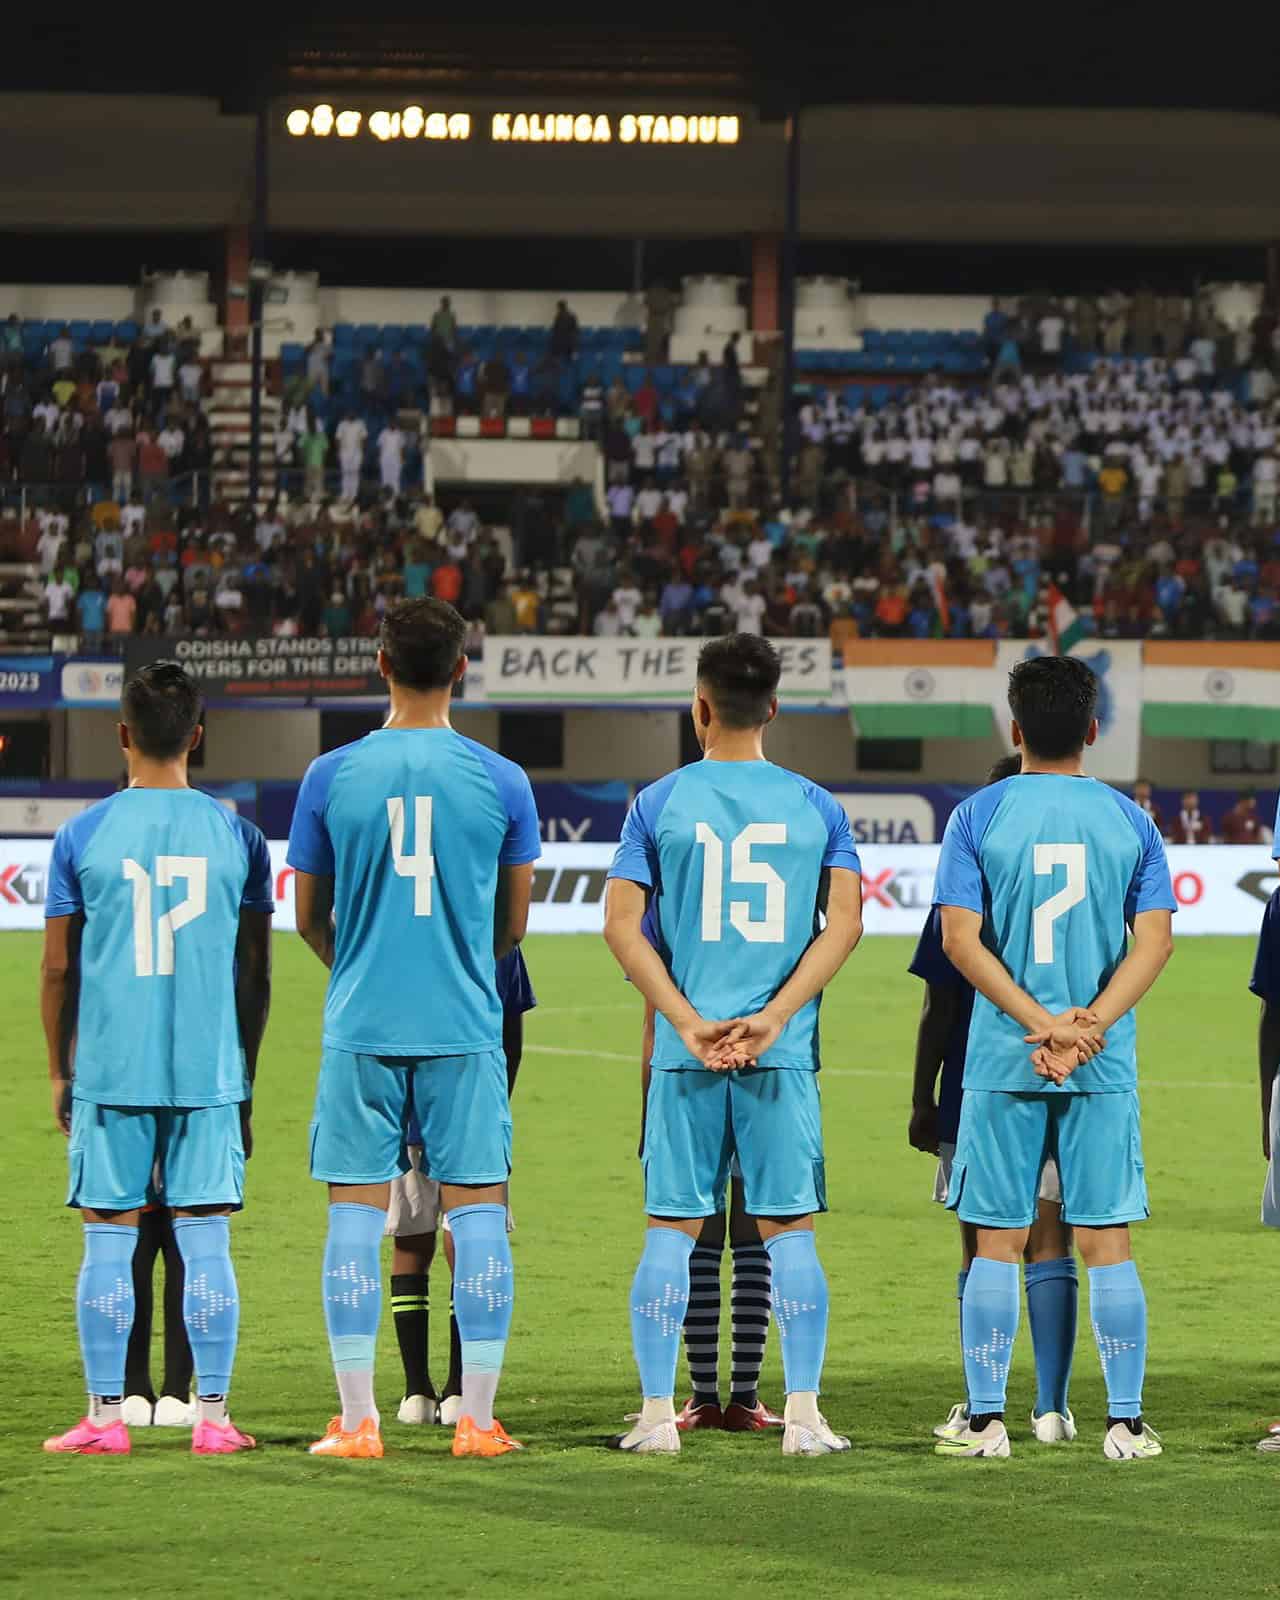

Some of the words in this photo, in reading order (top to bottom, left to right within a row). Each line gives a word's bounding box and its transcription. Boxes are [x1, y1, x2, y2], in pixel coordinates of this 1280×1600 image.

[493, 113, 612, 142] KALINGA
[619, 115, 739, 144] STADIUM
[176, 640, 252, 658] ODISHA
[255, 638, 332, 657] STANDS
[336, 637, 384, 654] STRO
[501, 647, 597, 679] BACK
[615, 647, 687, 680] THE
[0, 670, 40, 692] 2023
[247, 657, 287, 677] FOR
[291, 656, 328, 675] THE
[853, 819, 920, 844] SHA
[387, 796, 434, 916] 4
[695, 821, 788, 943] 15
[122, 855, 208, 976] 17
[1033, 843, 1085, 964] 7
